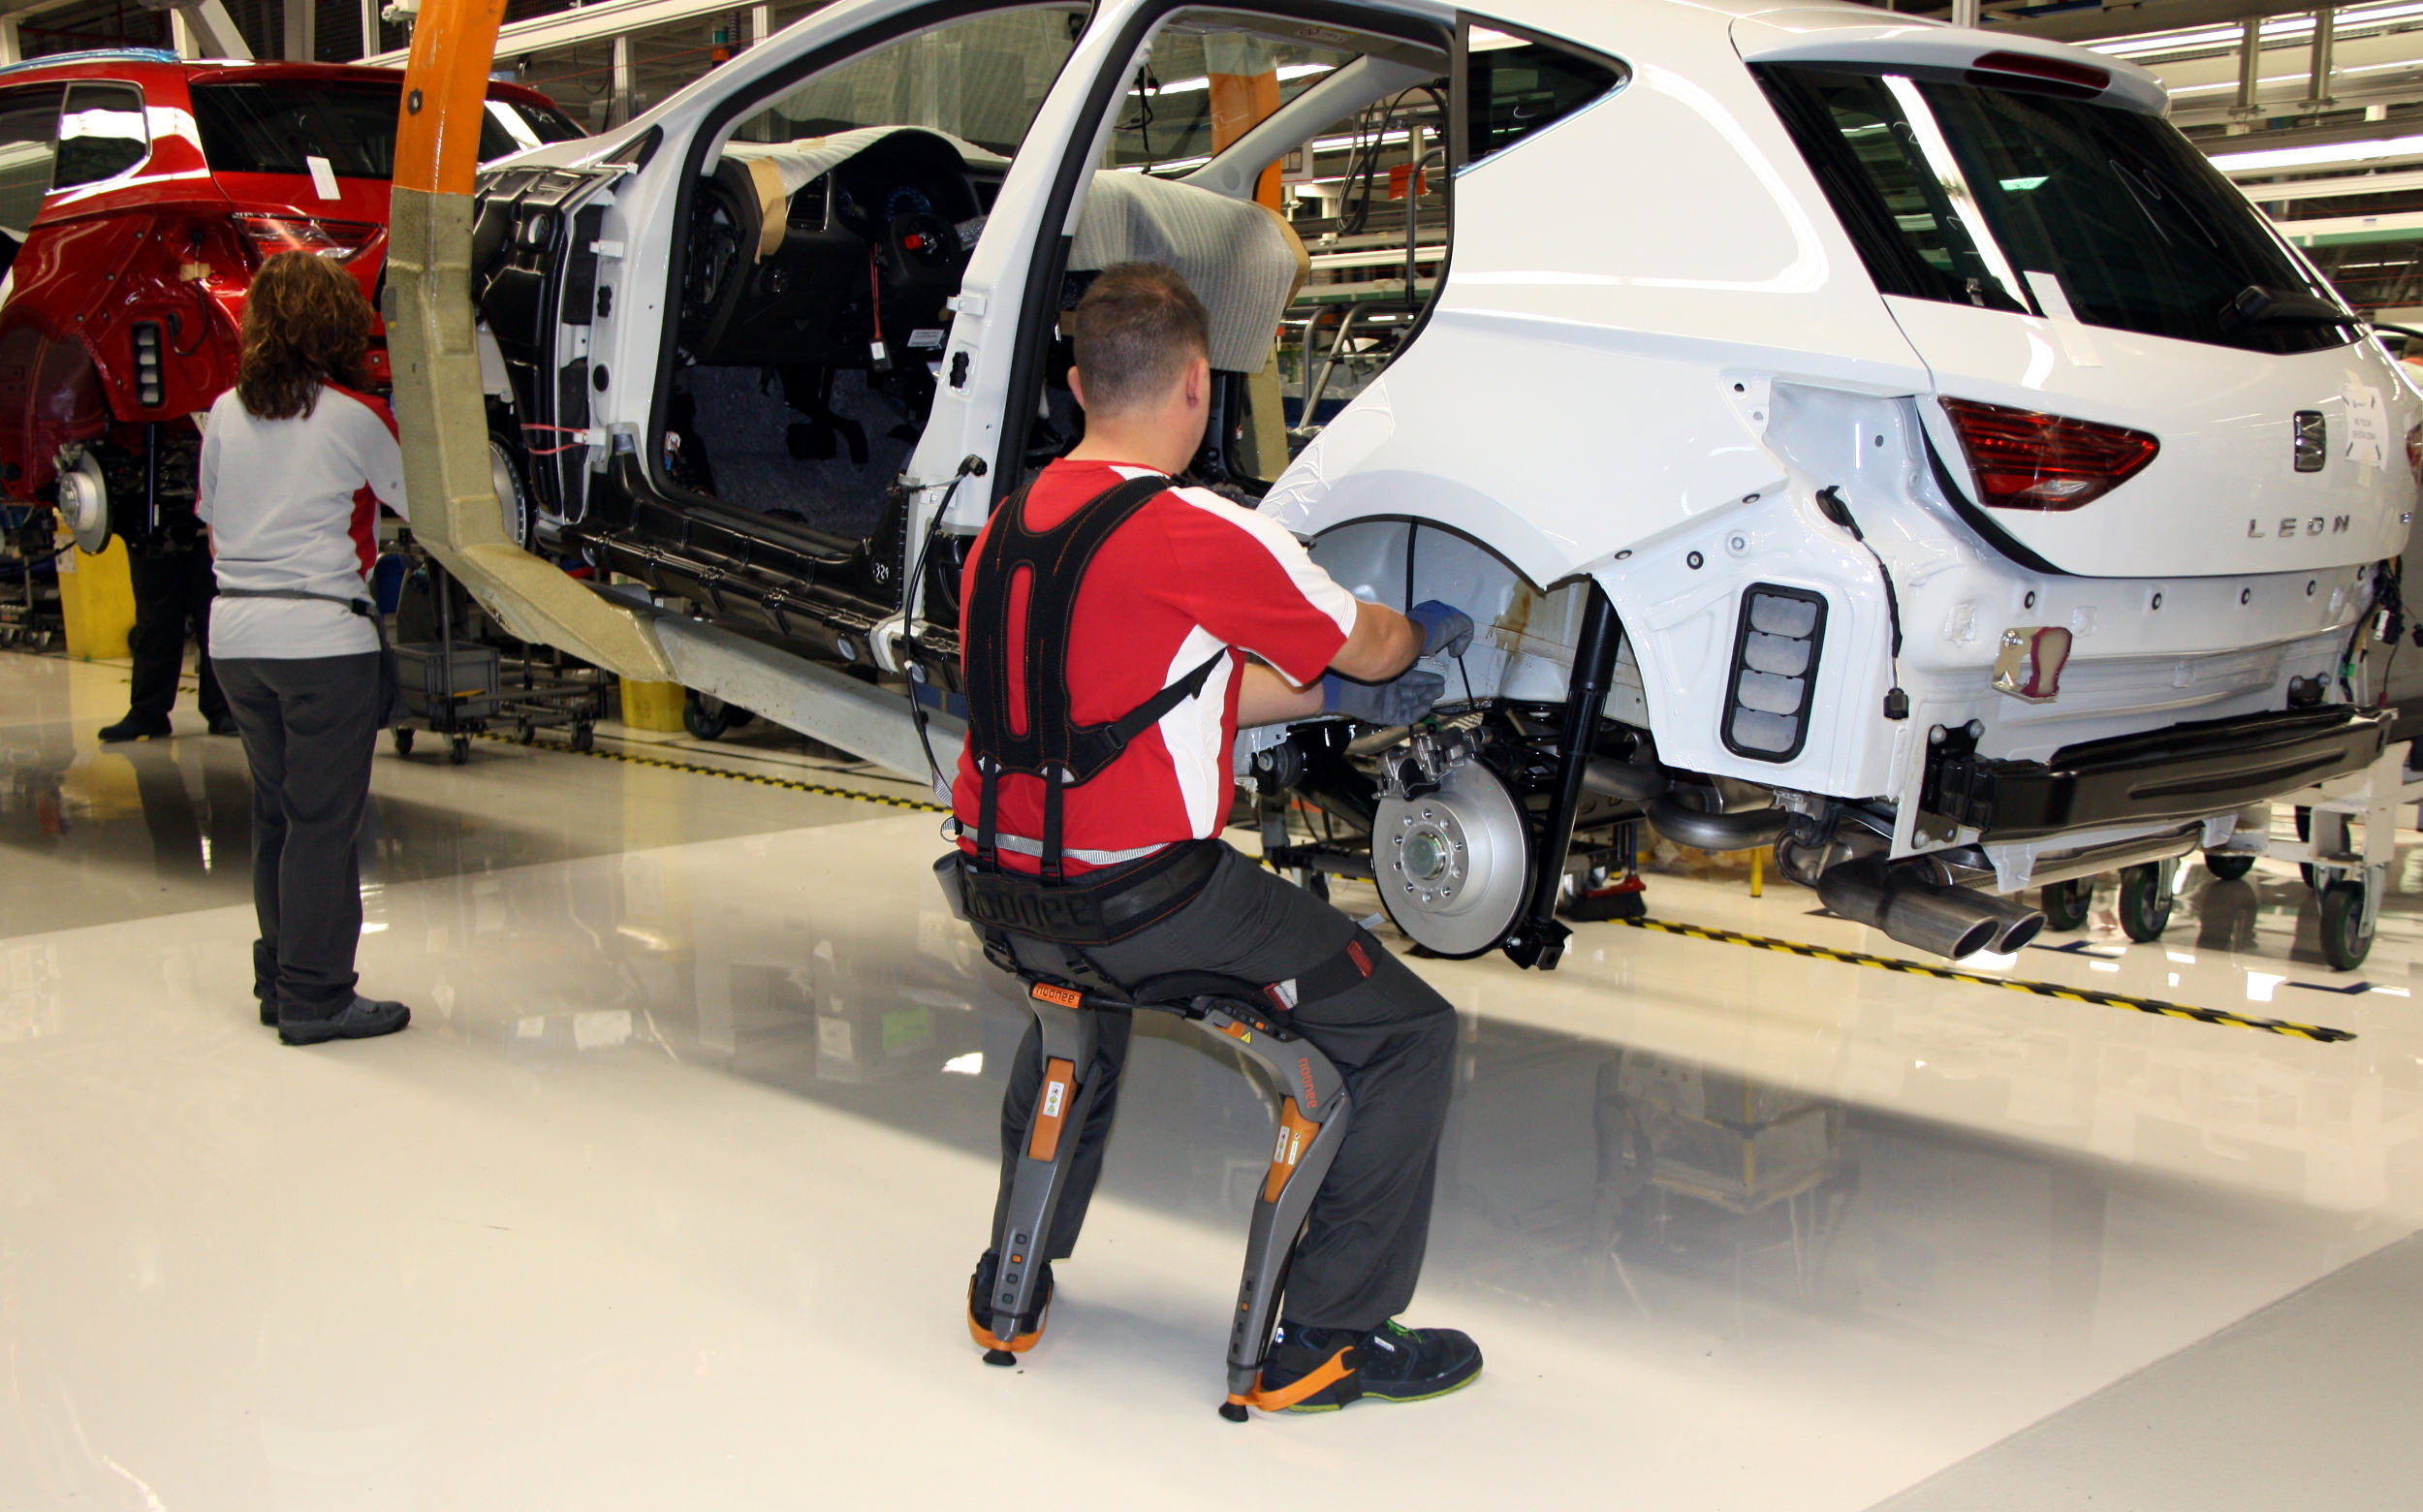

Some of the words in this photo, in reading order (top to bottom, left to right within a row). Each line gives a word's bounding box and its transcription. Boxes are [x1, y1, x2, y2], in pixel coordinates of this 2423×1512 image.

[2247, 514, 2350, 539] LEON
[1035, 985, 1076, 1004] noonee
[1298, 1057, 1318, 1110] noonee
